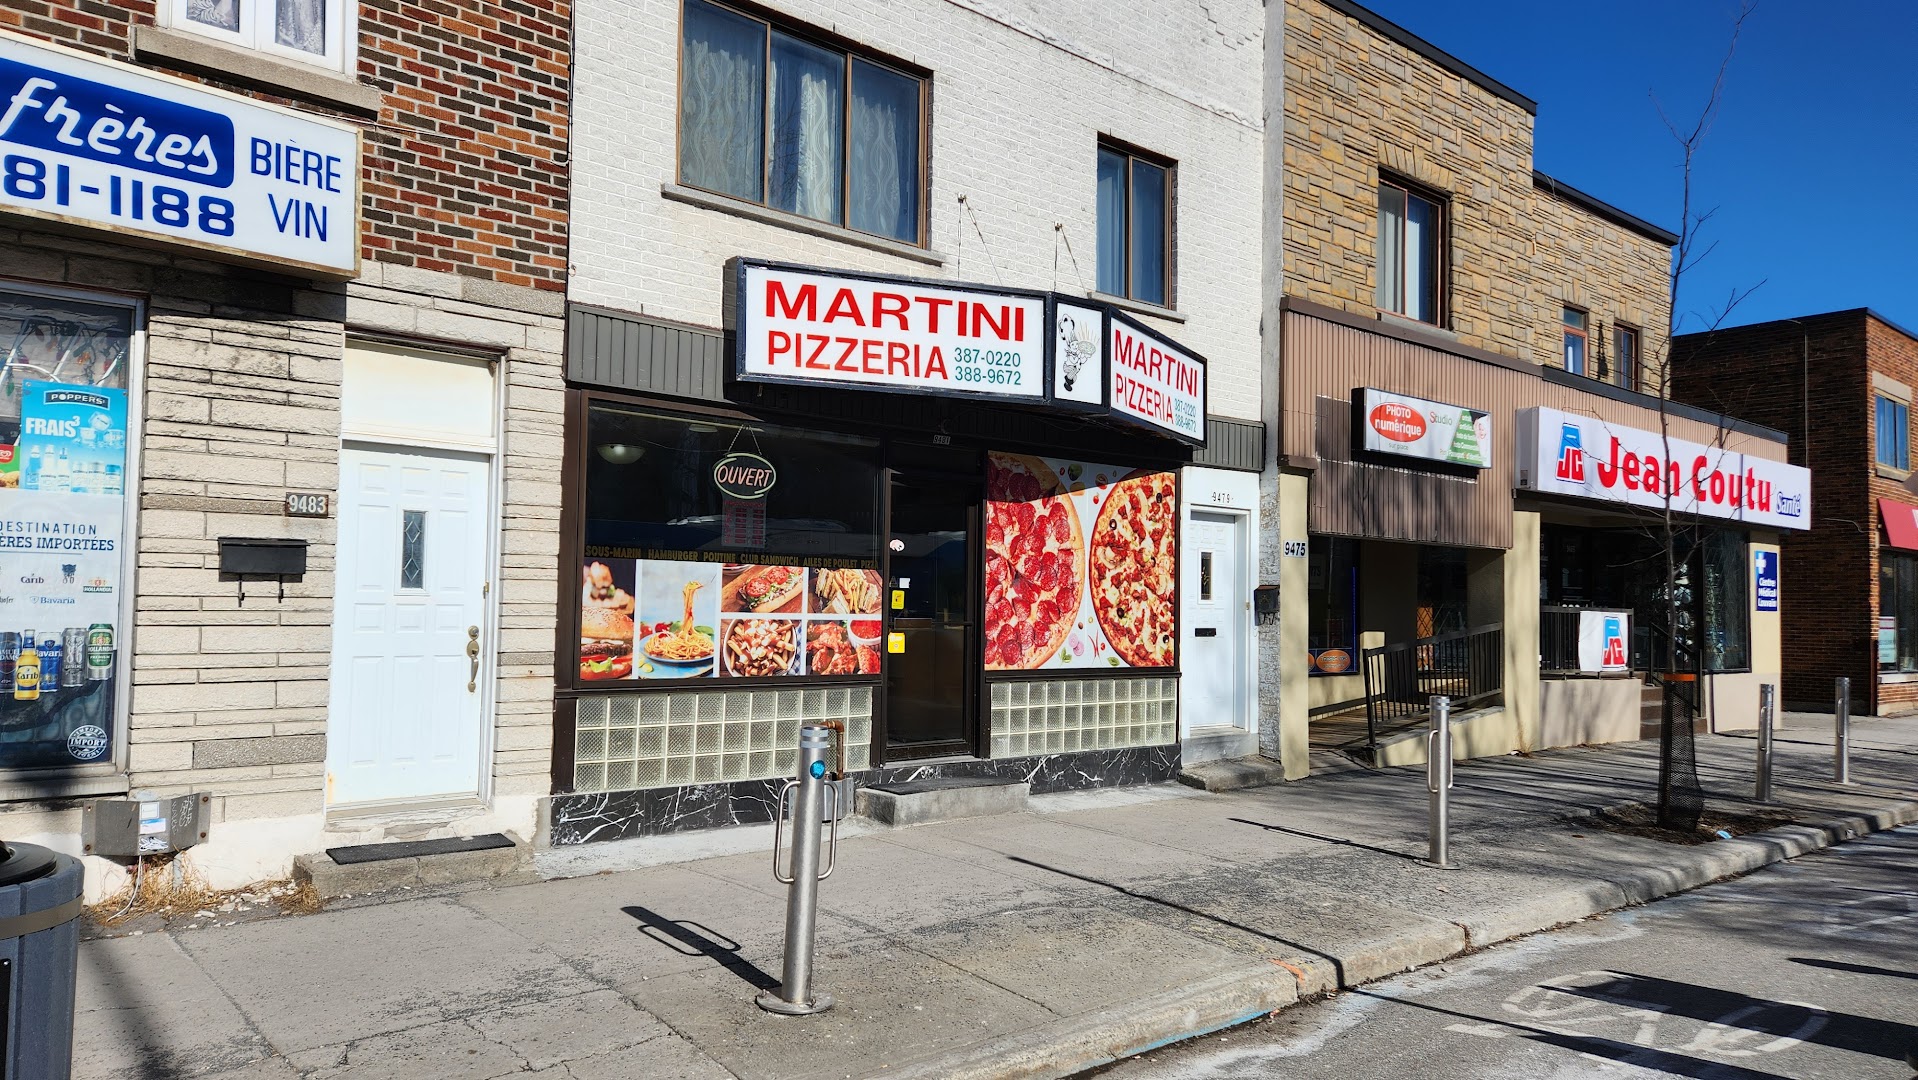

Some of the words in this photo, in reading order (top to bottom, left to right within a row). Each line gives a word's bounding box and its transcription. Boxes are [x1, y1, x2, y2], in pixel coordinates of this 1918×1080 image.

[0, 77, 218, 175] frères
[250, 136, 342, 194] BIÈRE
[3, 154, 235, 237] 81-1188
[268, 193, 328, 243] VIN
[765, 279, 1024, 342] MARTINI
[767, 330, 949, 380] PIZZERIA
[954, 347, 1021, 368] 387-0220
[1114, 329, 1198, 398] MARTINI
[955, 366, 1022, 386] 388-9672
[1115, 372, 1174, 425] PIZZERIA
[1174, 398, 1197, 418] 387-0220
[1386, 404, 1411, 418] PHOTO
[1429, 411, 1453, 426] Studio
[1374, 418, 1422, 438] numérique
[717, 465, 772, 487] OUVERT
[1597, 436, 1680, 497] Jean
[1691, 454, 1771, 513] Coutu
[288, 494, 327, 514] 9483
[1776, 491, 1801, 517] Santé
[37, 536, 114, 551] IMPORTÉES
[1284, 541, 1306, 557] 9475
[585, 545, 641, 559] SOUS-MARIN
[648, 548, 698, 562] HAMBURGER
[703, 551, 736, 563] POUTINE
[740, 554, 759, 564] CLUB
[760, 555, 799, 566] SANDWICH
[803, 557, 822, 567] AILES
[823, 558, 832, 567] DE
[833, 558, 858, 569] POULET
[40, 596, 75, 604] Bavaria
[16, 672, 39, 680] Carib
[70, 738, 106, 746] IMPORT
